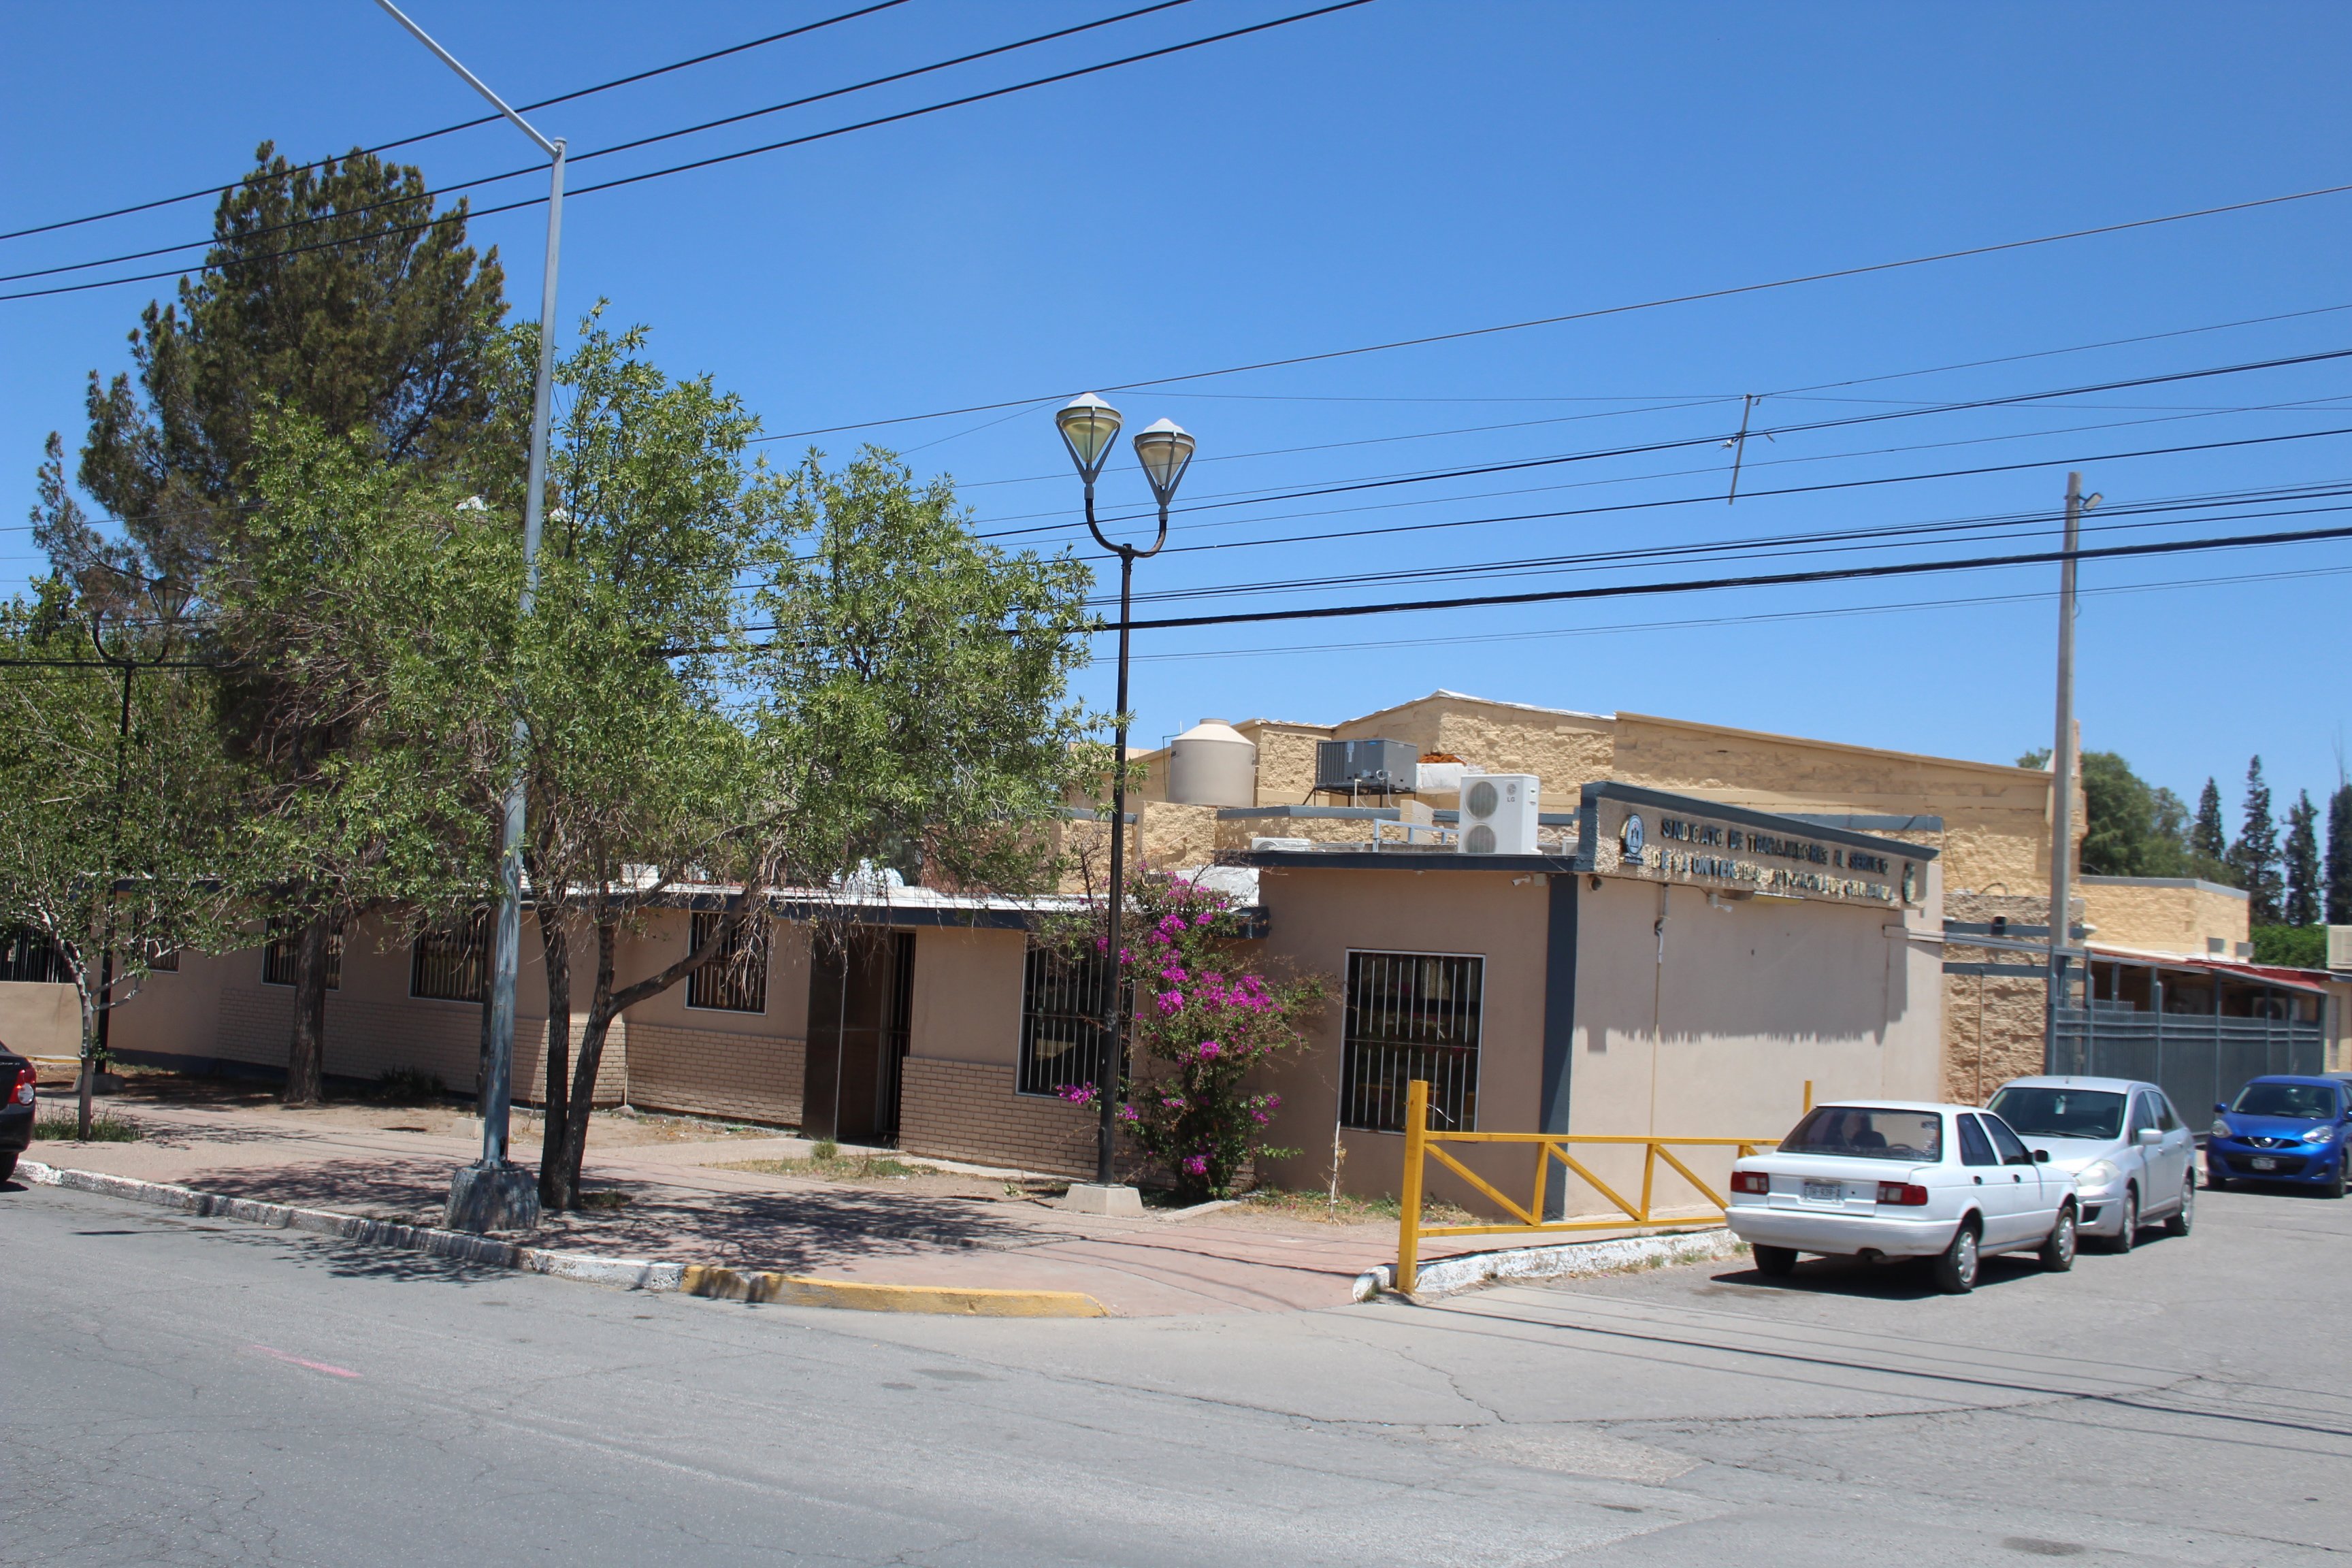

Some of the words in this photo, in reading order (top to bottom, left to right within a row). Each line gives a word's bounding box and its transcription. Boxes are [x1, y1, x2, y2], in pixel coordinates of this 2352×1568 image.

[1661, 818, 1723, 847] SINDICATO
[1728, 828, 1744, 850] DE
[1651, 850, 1671, 870] DE
